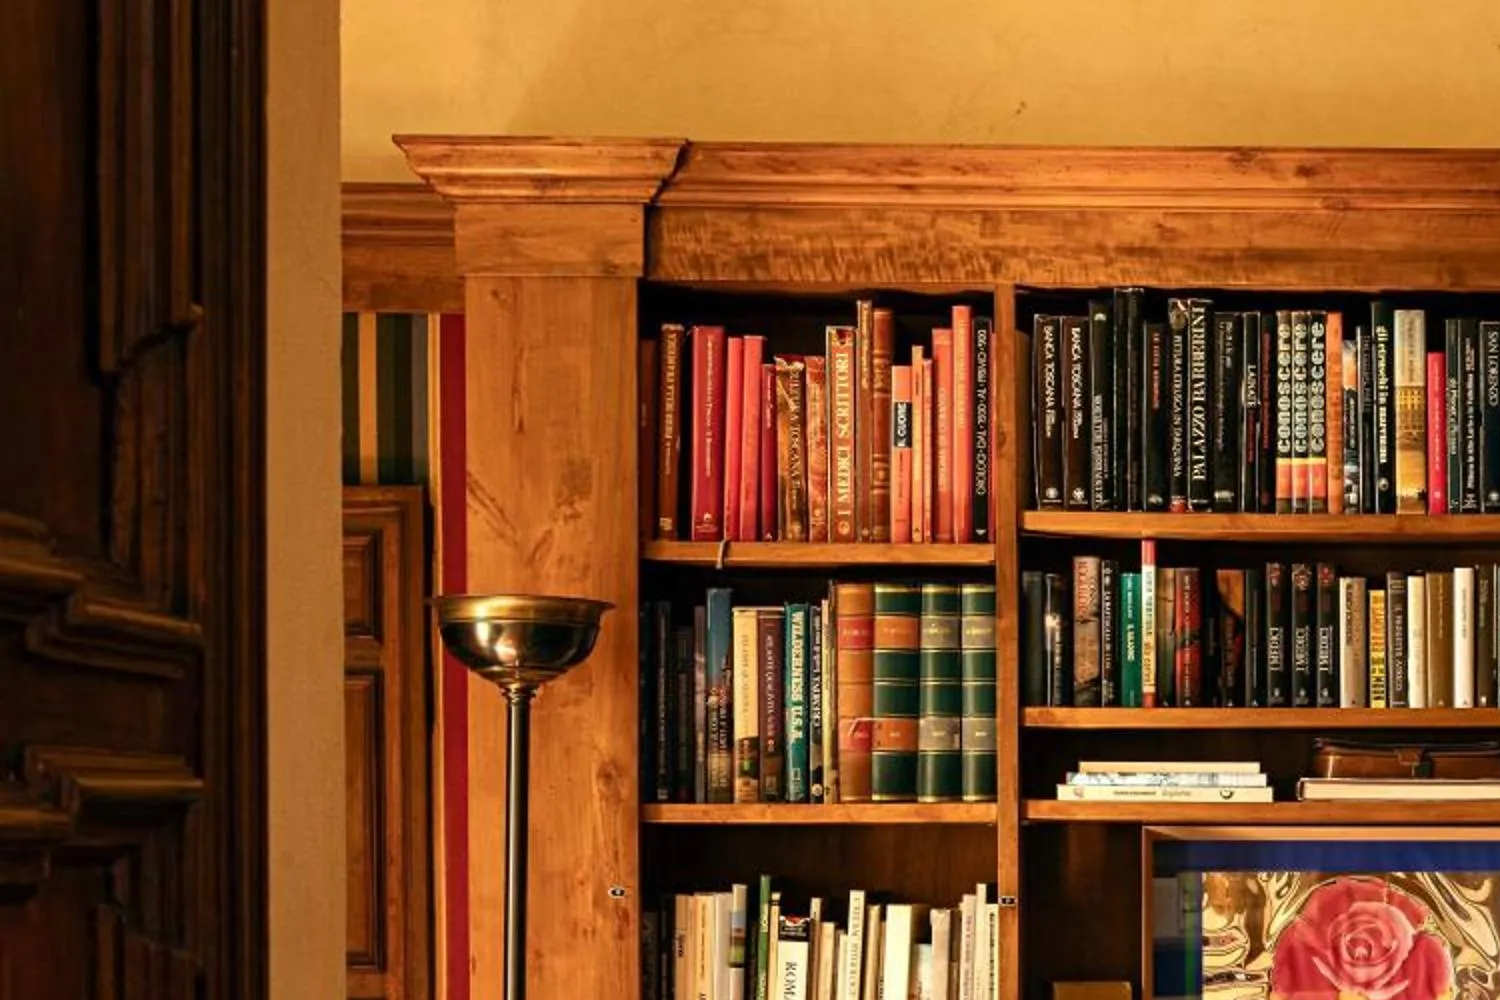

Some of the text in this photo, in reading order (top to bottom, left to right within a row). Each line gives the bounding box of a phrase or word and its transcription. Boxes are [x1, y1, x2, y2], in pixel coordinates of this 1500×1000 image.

[1045, 362, 1055, 408] TOSCANA
[1071, 327, 1081, 360] BANCA
[1071, 363, 1081, 408] TOSCANA
[1488, 331, 1499, 406] SAN LORENZO
[835, 353, 850, 438] SCRITTORI
[1191, 306, 1206, 480] PALAZZO BARBERINI
[1277, 323, 1291, 453] conoscere
[1293, 323, 1307, 453] conoscere
[1310, 322, 1325, 452] conoscere
[837, 445, 850, 504] MEDICI
[791, 611, 804, 701] WILDERNESS
